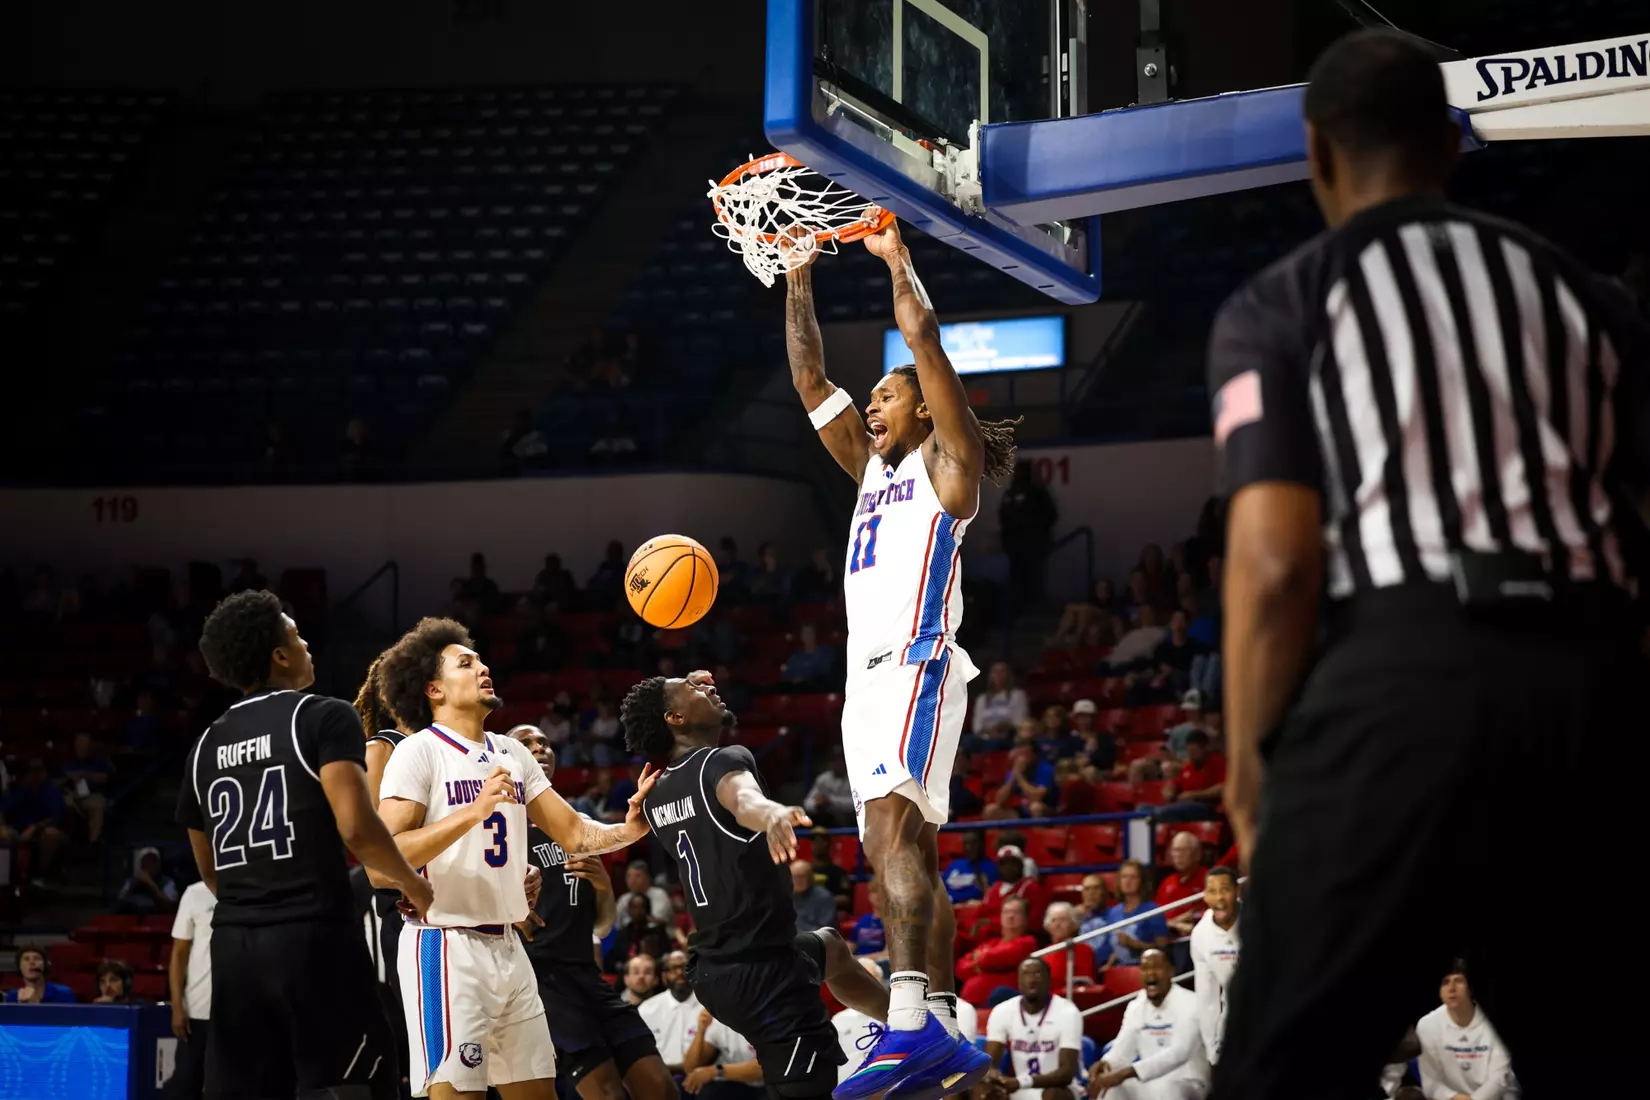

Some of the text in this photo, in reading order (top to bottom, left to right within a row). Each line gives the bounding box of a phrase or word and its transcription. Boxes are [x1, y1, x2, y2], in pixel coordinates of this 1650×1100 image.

[1476, 40, 1650, 102] SPALDIN
[1033, 456, 1071, 486] 01
[91, 495, 139, 524] 119
[850, 514, 883, 575] 11
[217, 734, 272, 770] RUFFIN
[445, 780, 487, 806] LOUIS
[208, 765, 296, 871] 24
[652, 796, 696, 828] MCMILLIAN
[483, 811, 508, 868] 3
[532, 841, 572, 869] TIG
[676, 830, 709, 907] 1
[563, 872, 579, 906] 7
